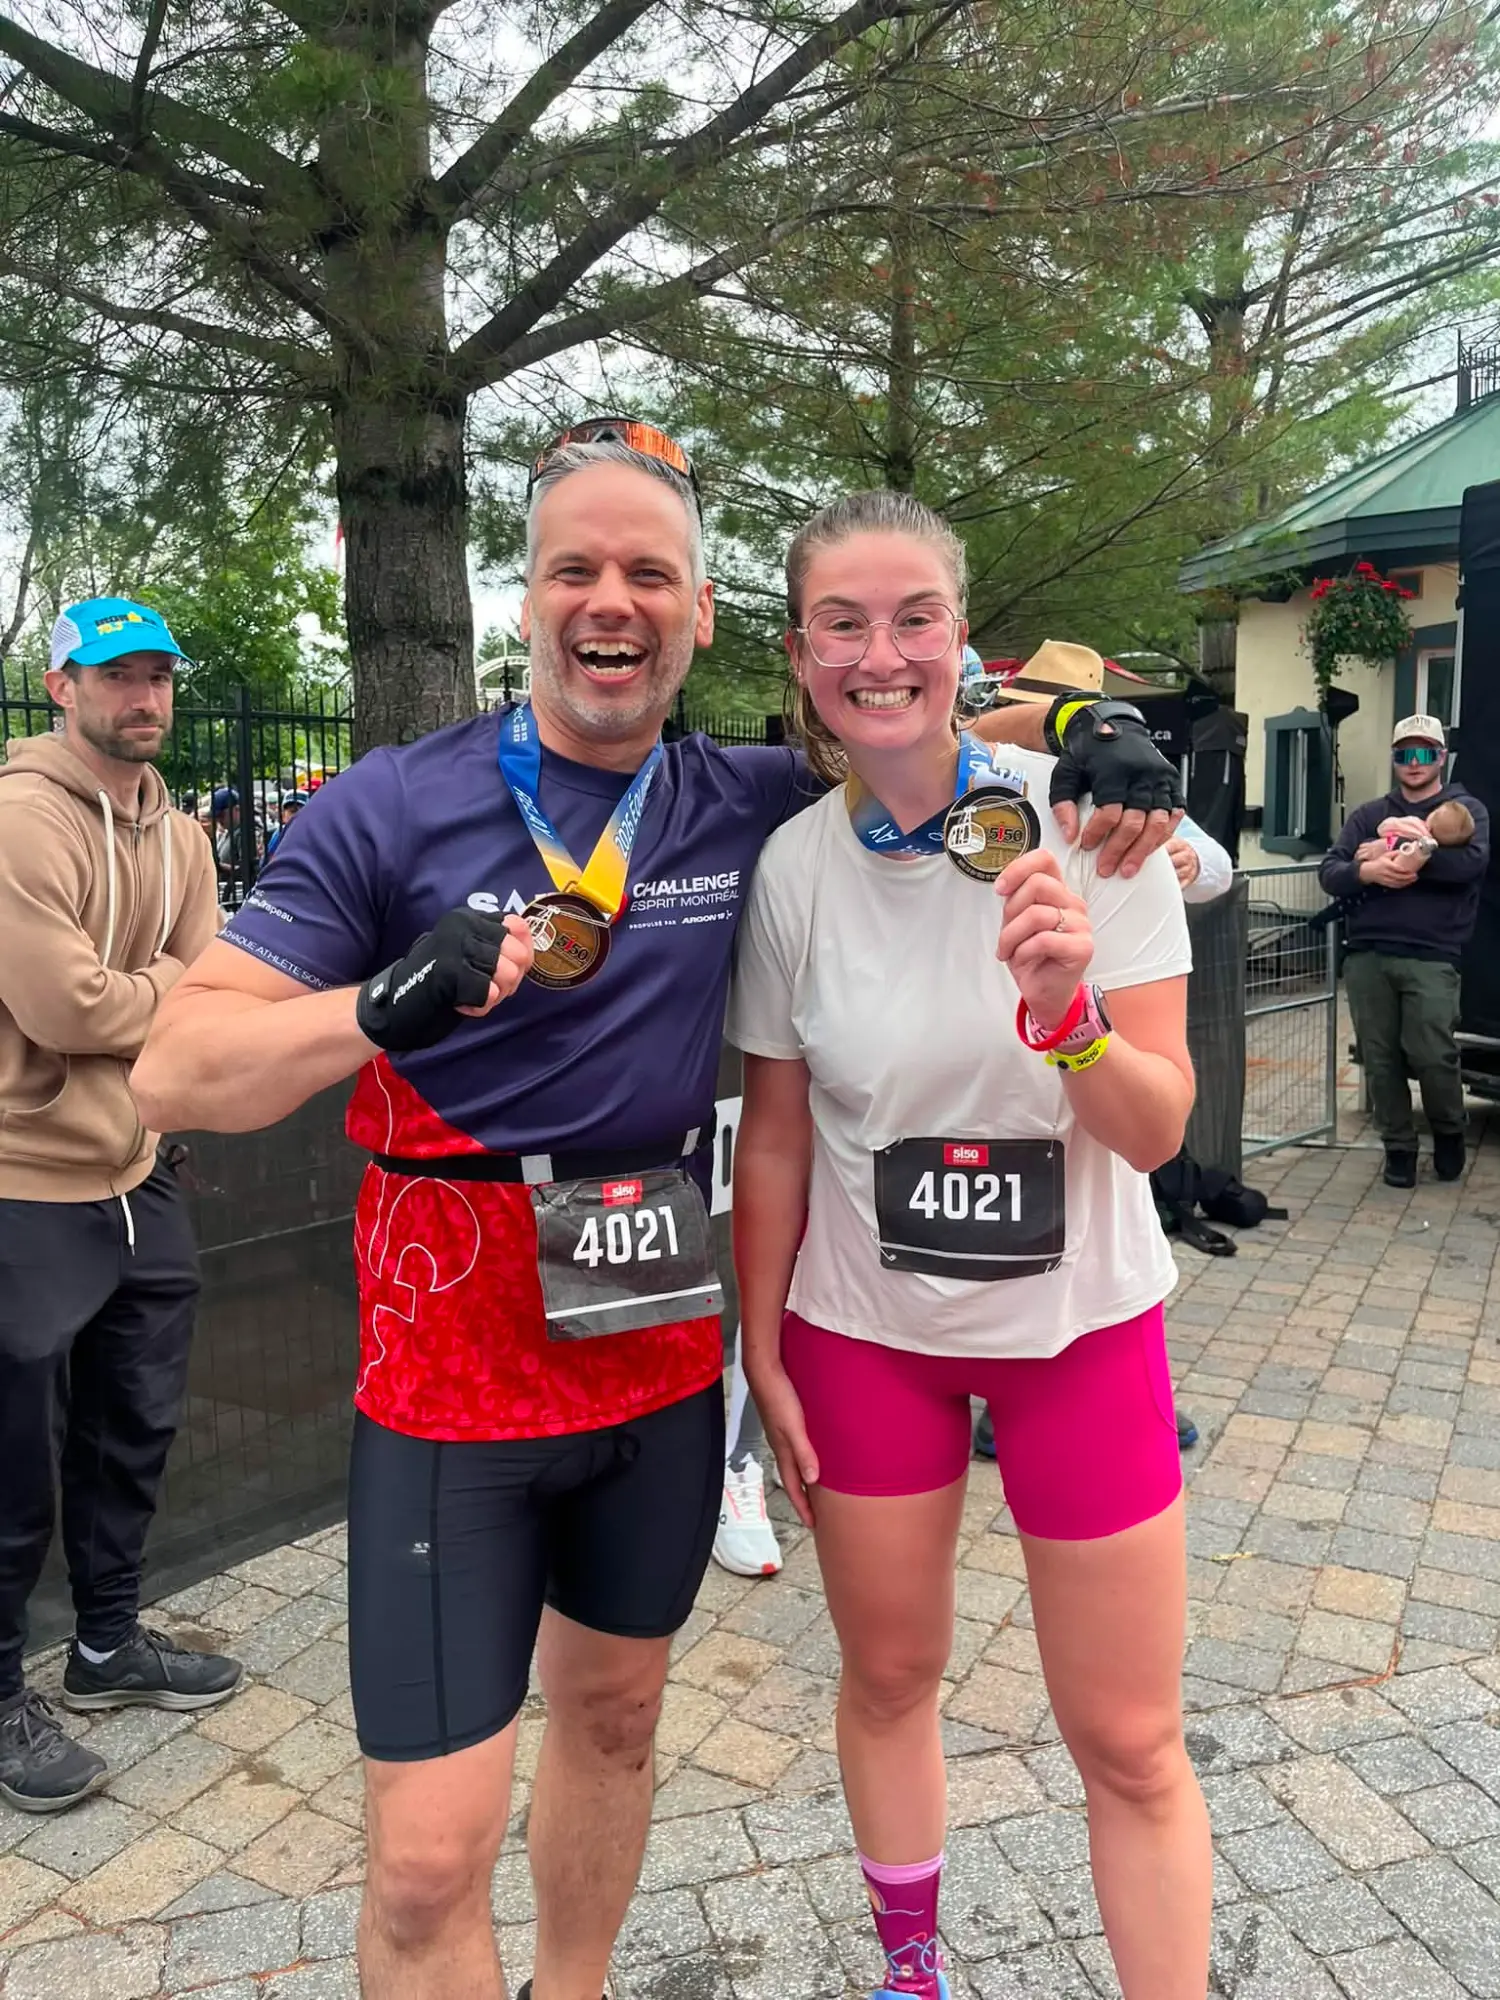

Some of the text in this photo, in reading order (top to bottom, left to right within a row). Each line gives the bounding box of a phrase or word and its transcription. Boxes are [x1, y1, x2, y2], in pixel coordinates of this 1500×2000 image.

[1150, 731, 1172, 741] .ca
[632, 870, 740, 899] CHALLENGE
[630, 888, 739, 912] ESPRIT MONTRÉAL
[664, 919, 677, 927] PAR
[681, 912, 717, 925] ARGON
[225, 929, 258, 951] CHAQUE
[302, 970, 324, 987] SON
[909, 1171, 1021, 1222] 4021
[573, 1204, 679, 1268] 4021
